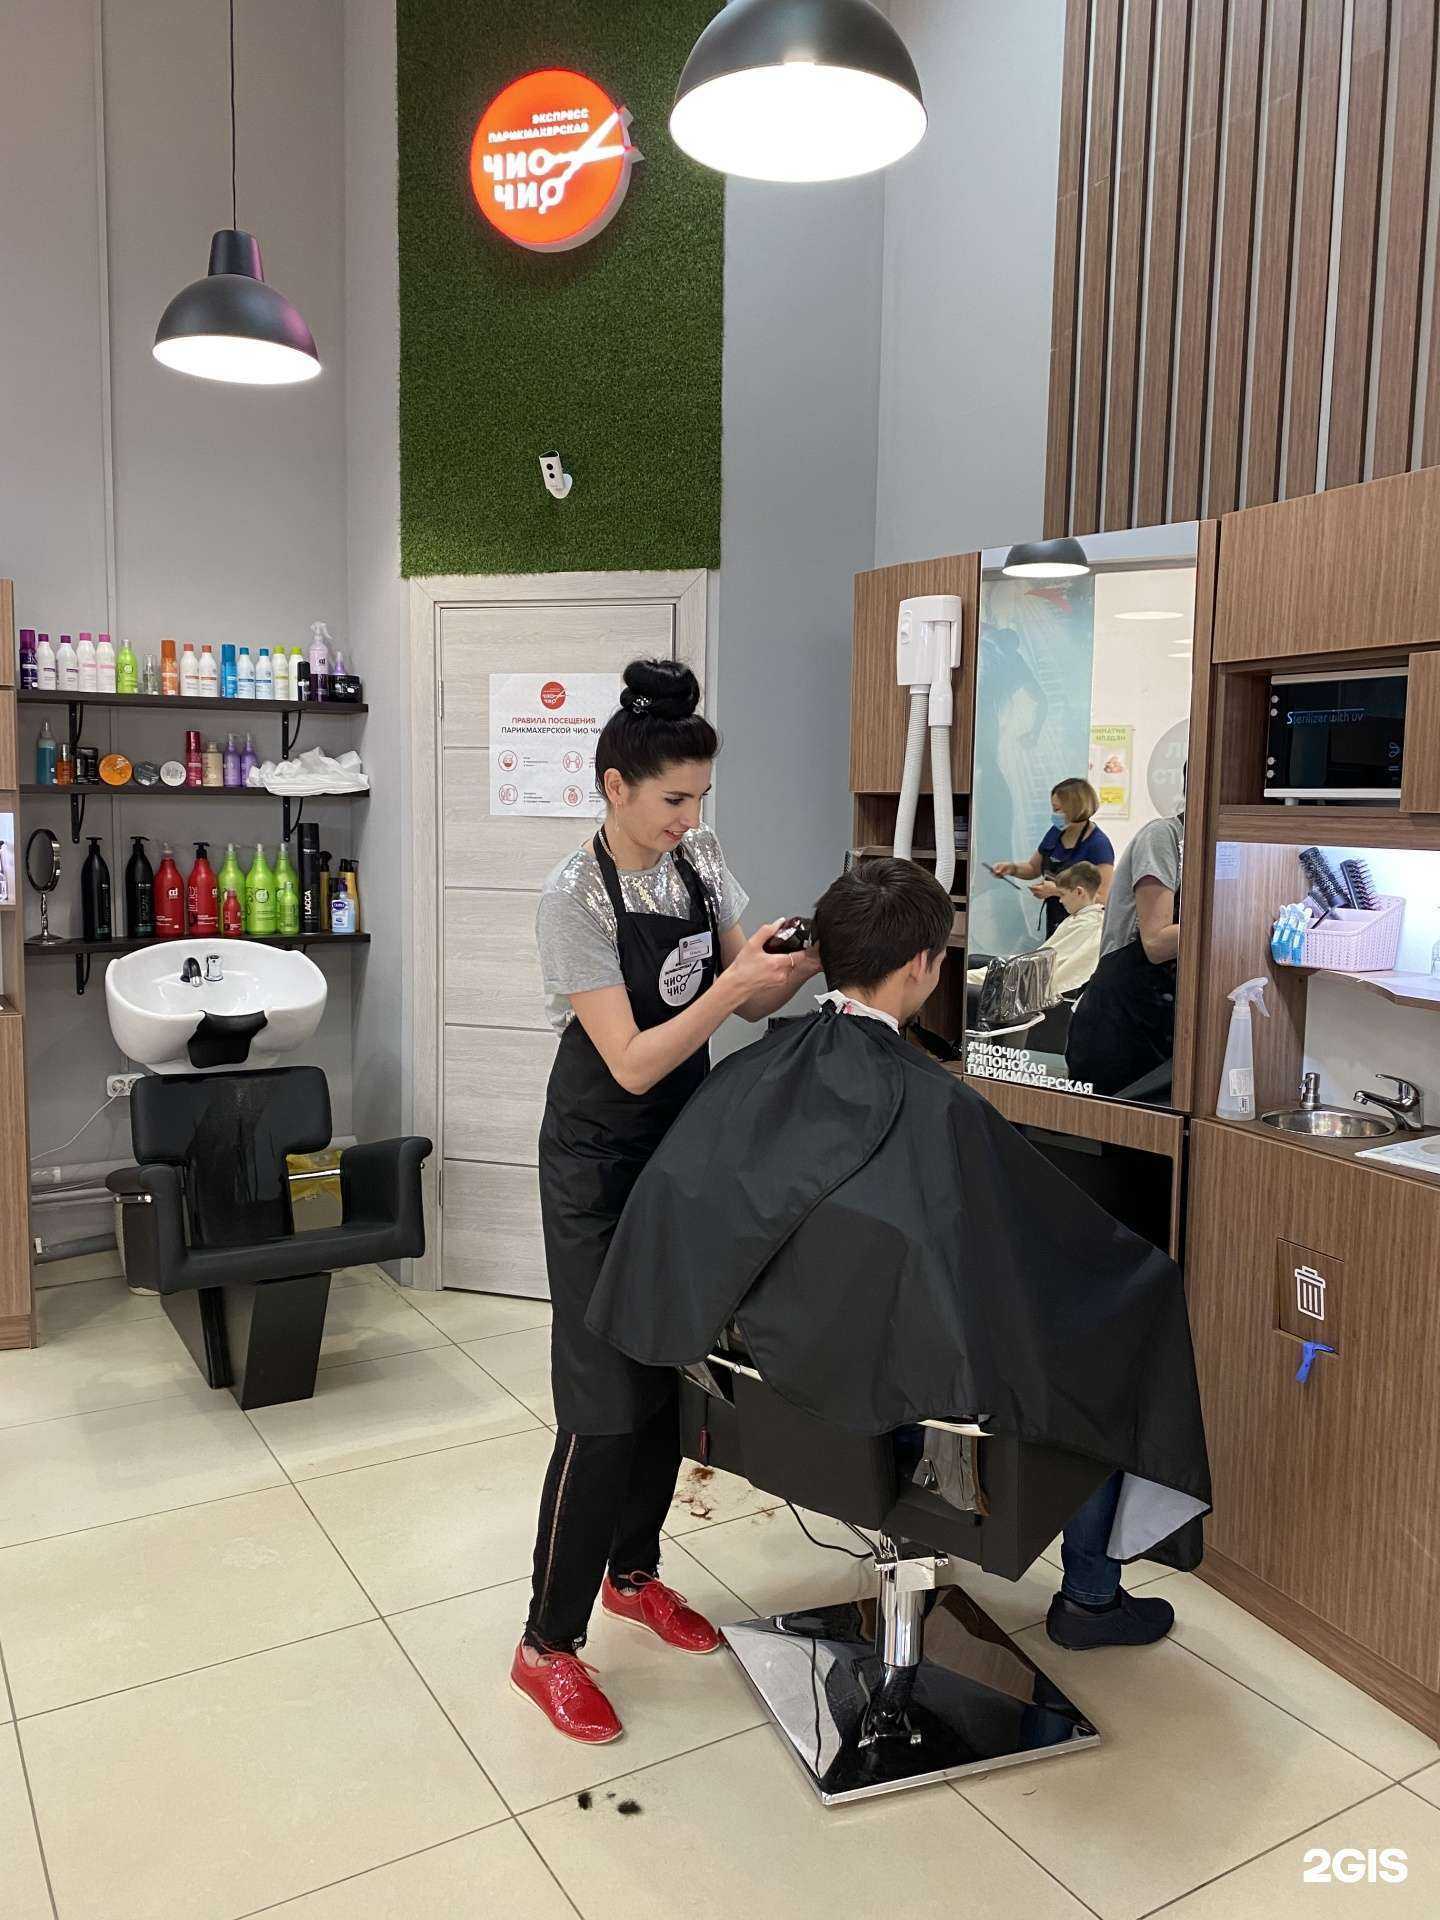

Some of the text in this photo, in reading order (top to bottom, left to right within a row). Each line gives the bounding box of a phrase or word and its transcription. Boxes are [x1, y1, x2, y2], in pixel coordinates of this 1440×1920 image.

[532, 108, 589, 124] ЭКСПРЕСС
[488, 123, 589, 143] ПАРИКМАХЕРСКАЯ
[483, 148, 553, 180] ЧИО
[494, 178, 564, 213] ЧИО
[501, 726, 571, 734] ПАРИКМАХЕРСКОЙ
[548, 717, 596, 725] ПОСЕЩЕНИЯ
[304, 889, 312, 915] LACCA
[663, 975, 683, 987] ЧИО
[667, 984, 686, 996] ЧИО
[967, 1041, 1030, 1061] #ЧИОЧИО
[967, 1053, 1047, 1076] #ЯПОНСКАЯ
[967, 1064, 1094, 1095] ПАРИКМАХЕРСКАЯ
